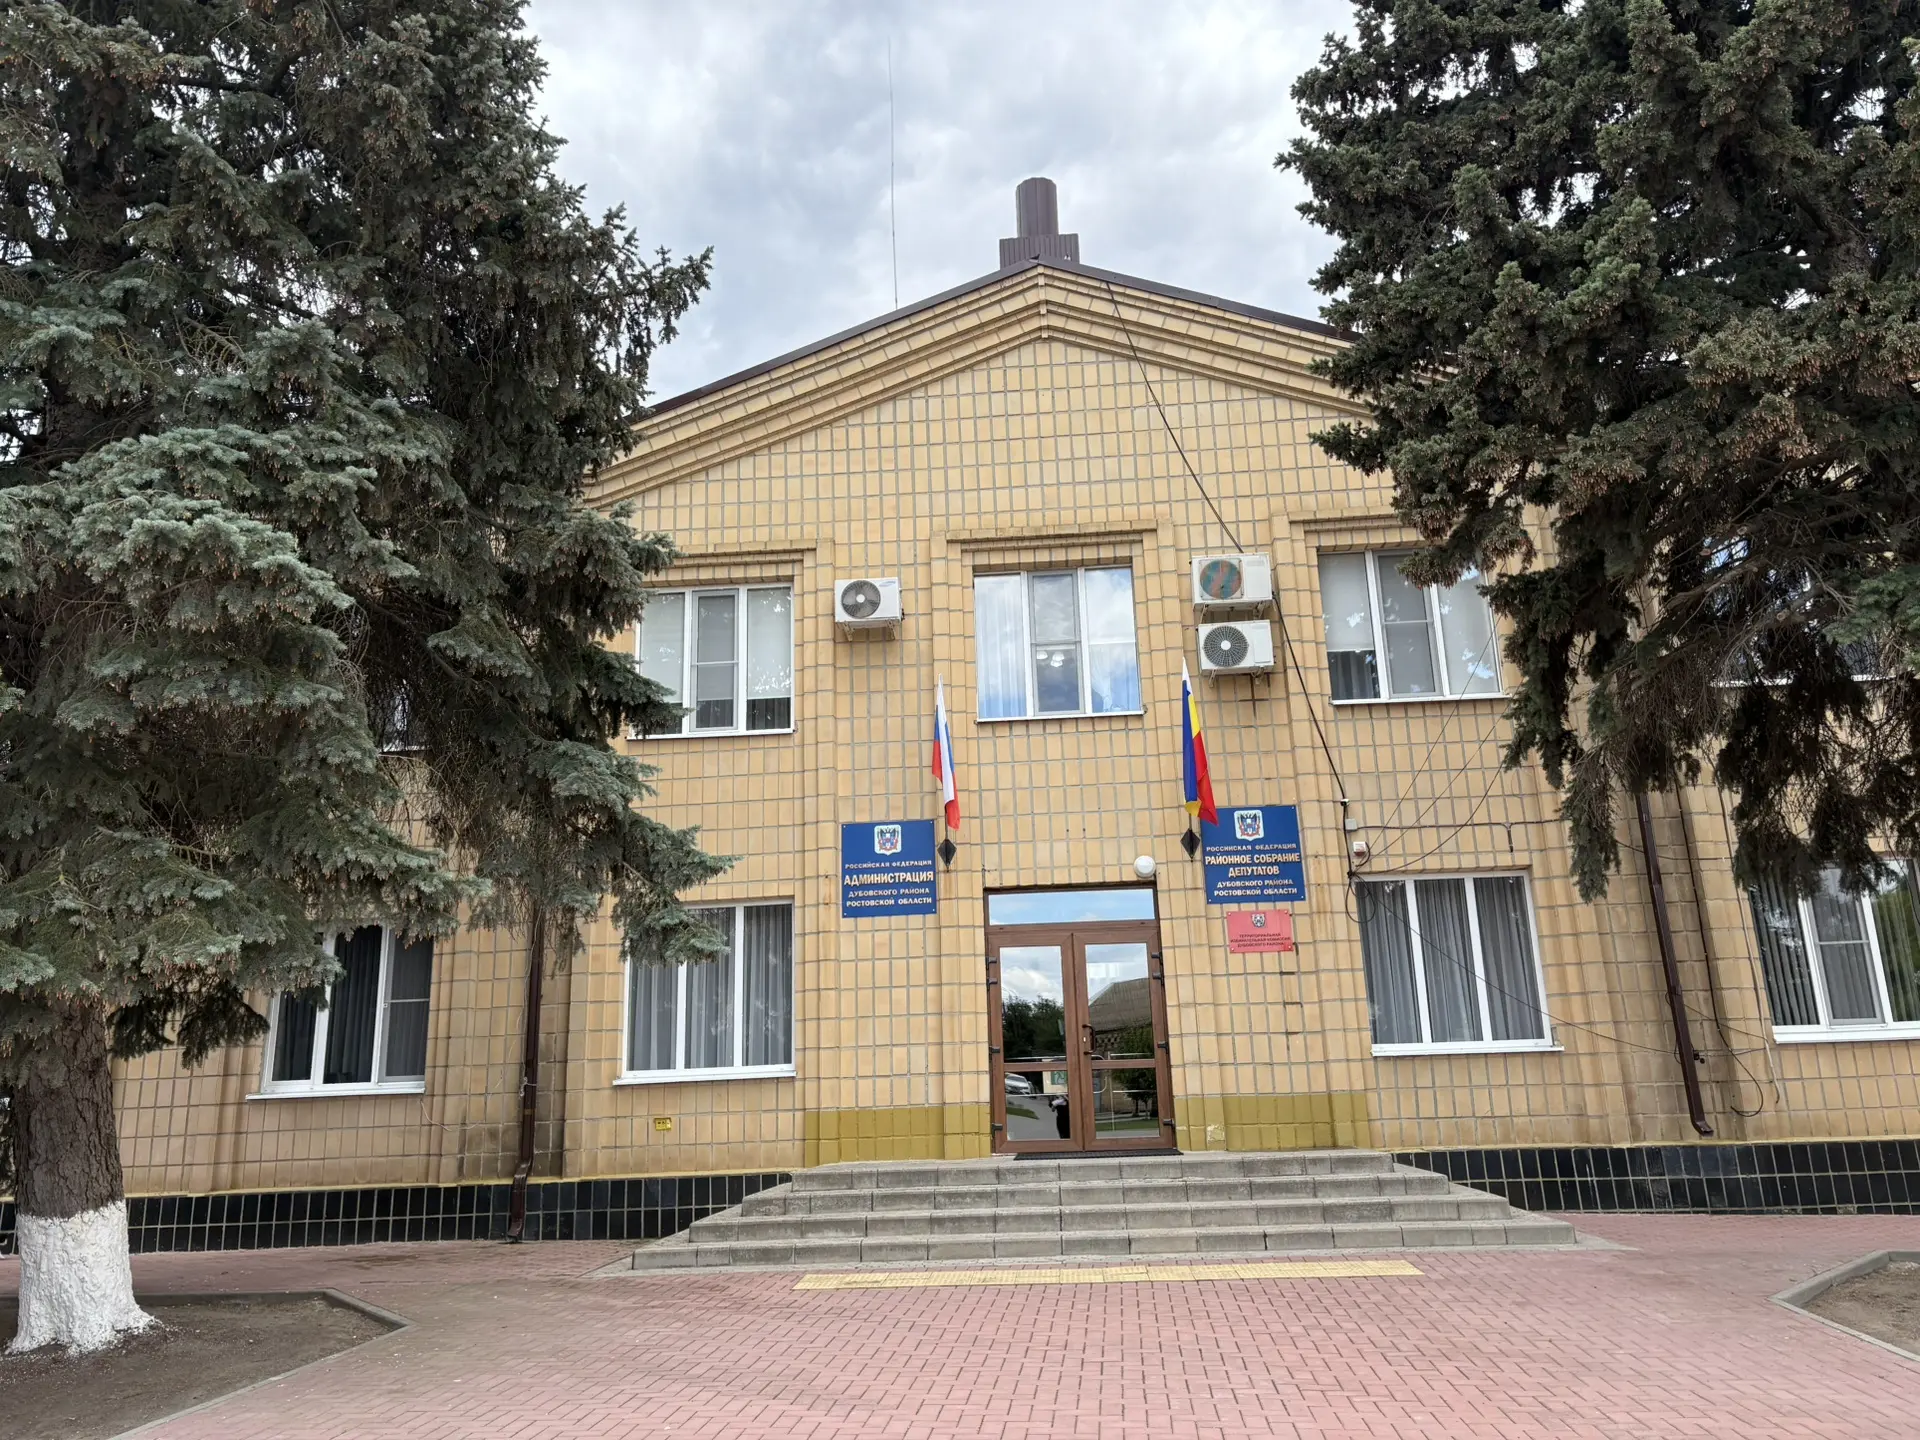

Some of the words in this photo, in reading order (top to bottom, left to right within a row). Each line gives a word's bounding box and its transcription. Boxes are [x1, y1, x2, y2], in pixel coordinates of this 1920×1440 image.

[1205, 853, 1252, 865] РАЙОННОЕ
[1254, 853, 1300, 863] СОБРАНИЕ
[845, 861, 890, 869] РОССИЙСКАЯ
[1229, 866, 1279, 877] ДЕПУТАТОВ
[844, 871, 933, 886] АДМИНИСТРАЦИЯ
[1217, 880, 1262, 888] ДУБОВСКОГО
[848, 889, 897, 898] ДУБОВСКОГО
[1214, 888, 1261, 896] РОСТОВСКОЙ
[847, 898, 894, 907] РОСТОВСКОЙ
